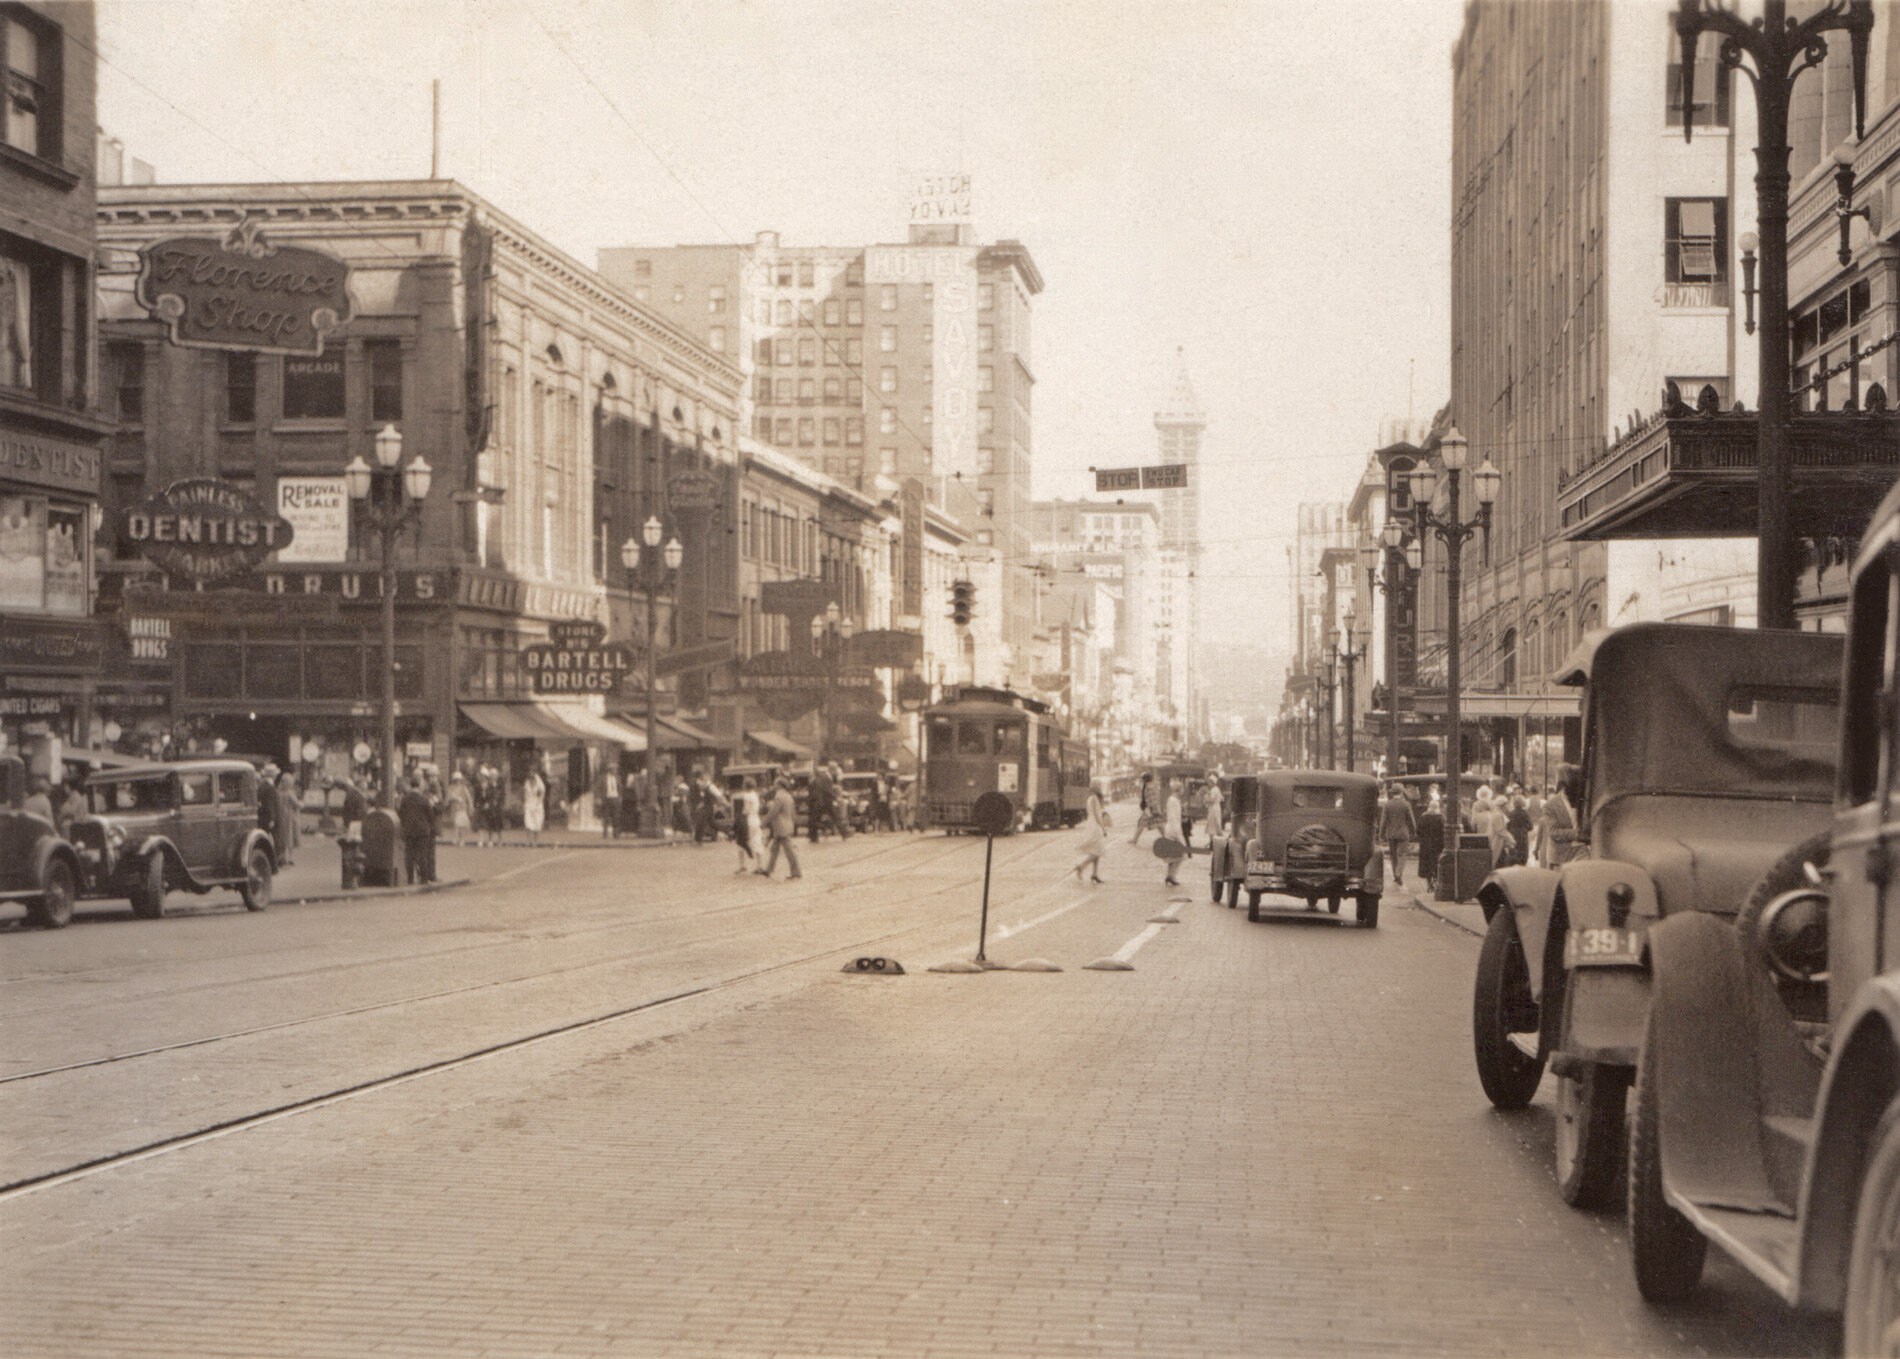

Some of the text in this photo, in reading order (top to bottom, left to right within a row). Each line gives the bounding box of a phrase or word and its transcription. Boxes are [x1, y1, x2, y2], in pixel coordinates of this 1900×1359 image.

[158, 250, 335, 294] Florence
[874, 251, 967, 277] HOTEL
[199, 296, 300, 343] Shop
[942, 281, 969, 459] SAVOY
[1096, 471, 1137, 489] STOP
[282, 485, 344, 508] REMOVAL
[304, 499, 340, 509] SALE
[129, 514, 281, 547] DENTIST
[131, 618, 171, 638] BARTELL
[133, 639, 167, 658] DRUGS
[527, 651, 627, 669] BARTELL
[541, 671, 613, 689] DRUGS
